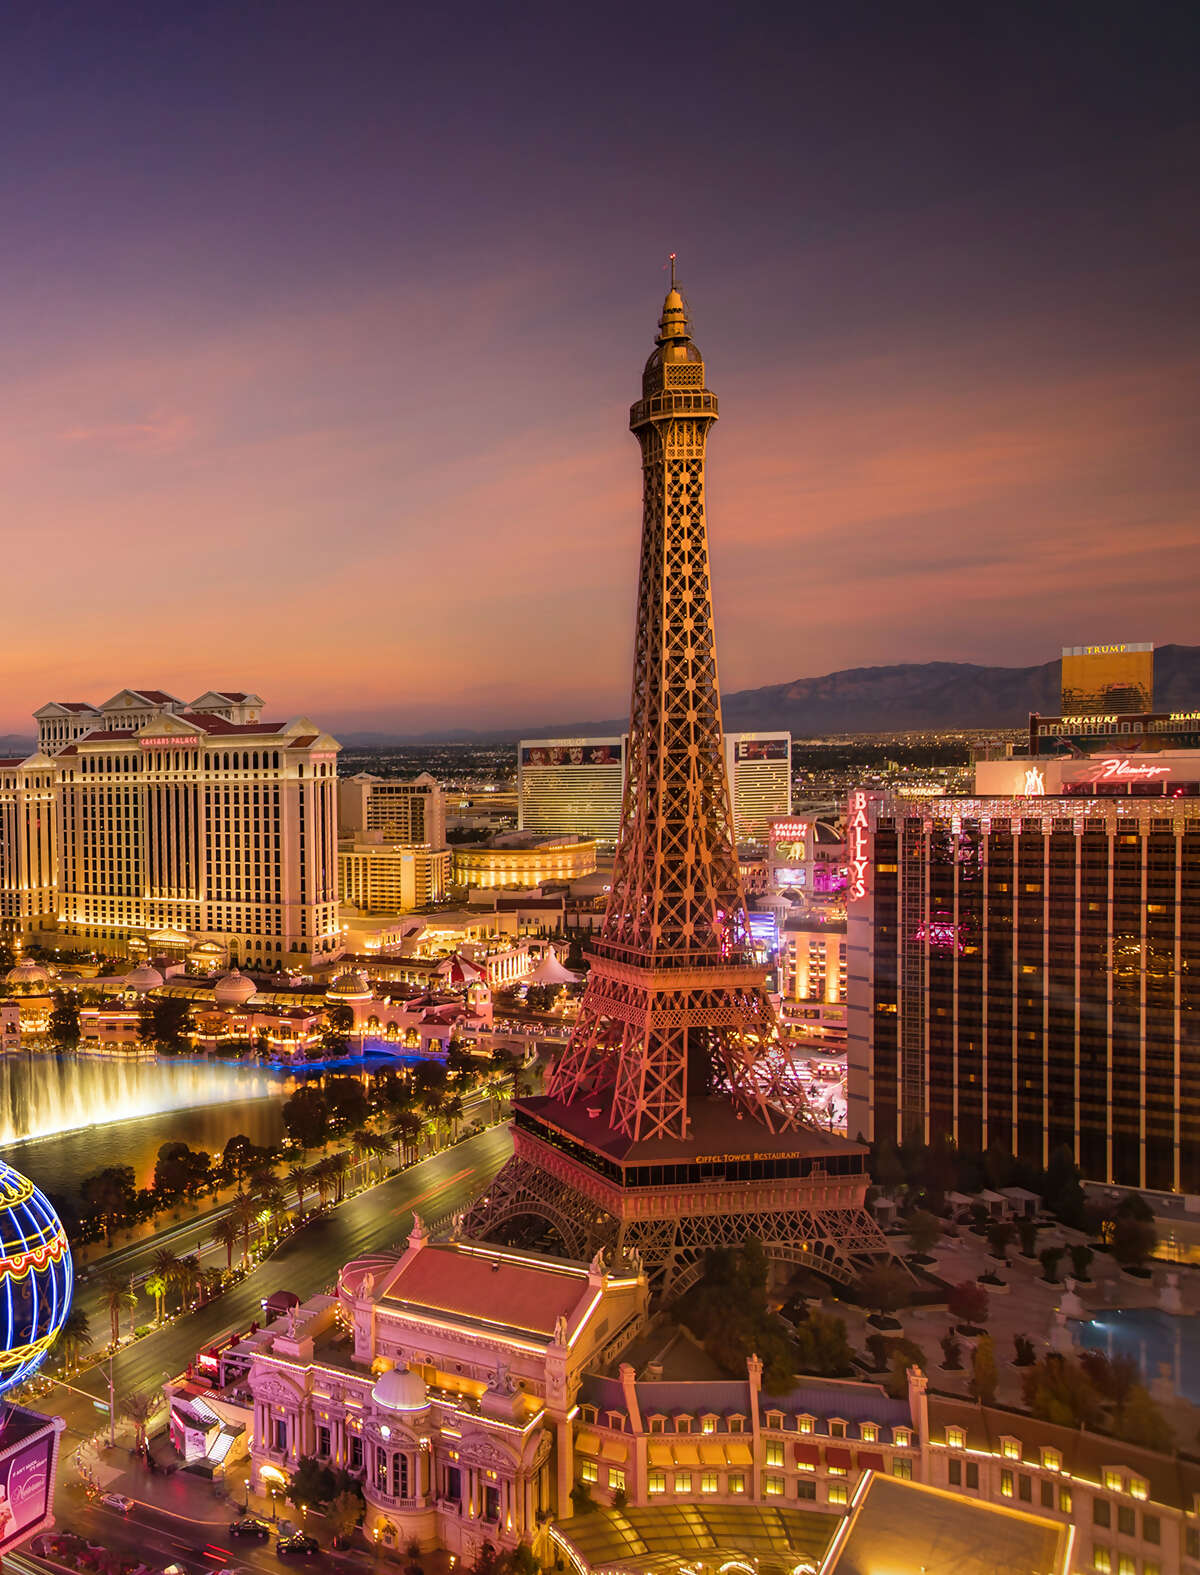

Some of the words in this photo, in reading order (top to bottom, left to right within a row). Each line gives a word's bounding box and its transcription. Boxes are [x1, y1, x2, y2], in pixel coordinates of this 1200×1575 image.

[1087, 644, 1126, 654] TRUMP
[1062, 716, 1118, 724] TREASURE
[140, 738, 169, 746] CAESARS
[170, 736, 198, 745] PALACE
[1100, 759, 1171, 778] Flamingo
[774, 823, 808, 831] CAESARS
[695, 1155, 721, 1164] EIFFEL
[723, 1153, 751, 1162] TOWER
[753, 1151, 801, 1160] RESTAURANT
